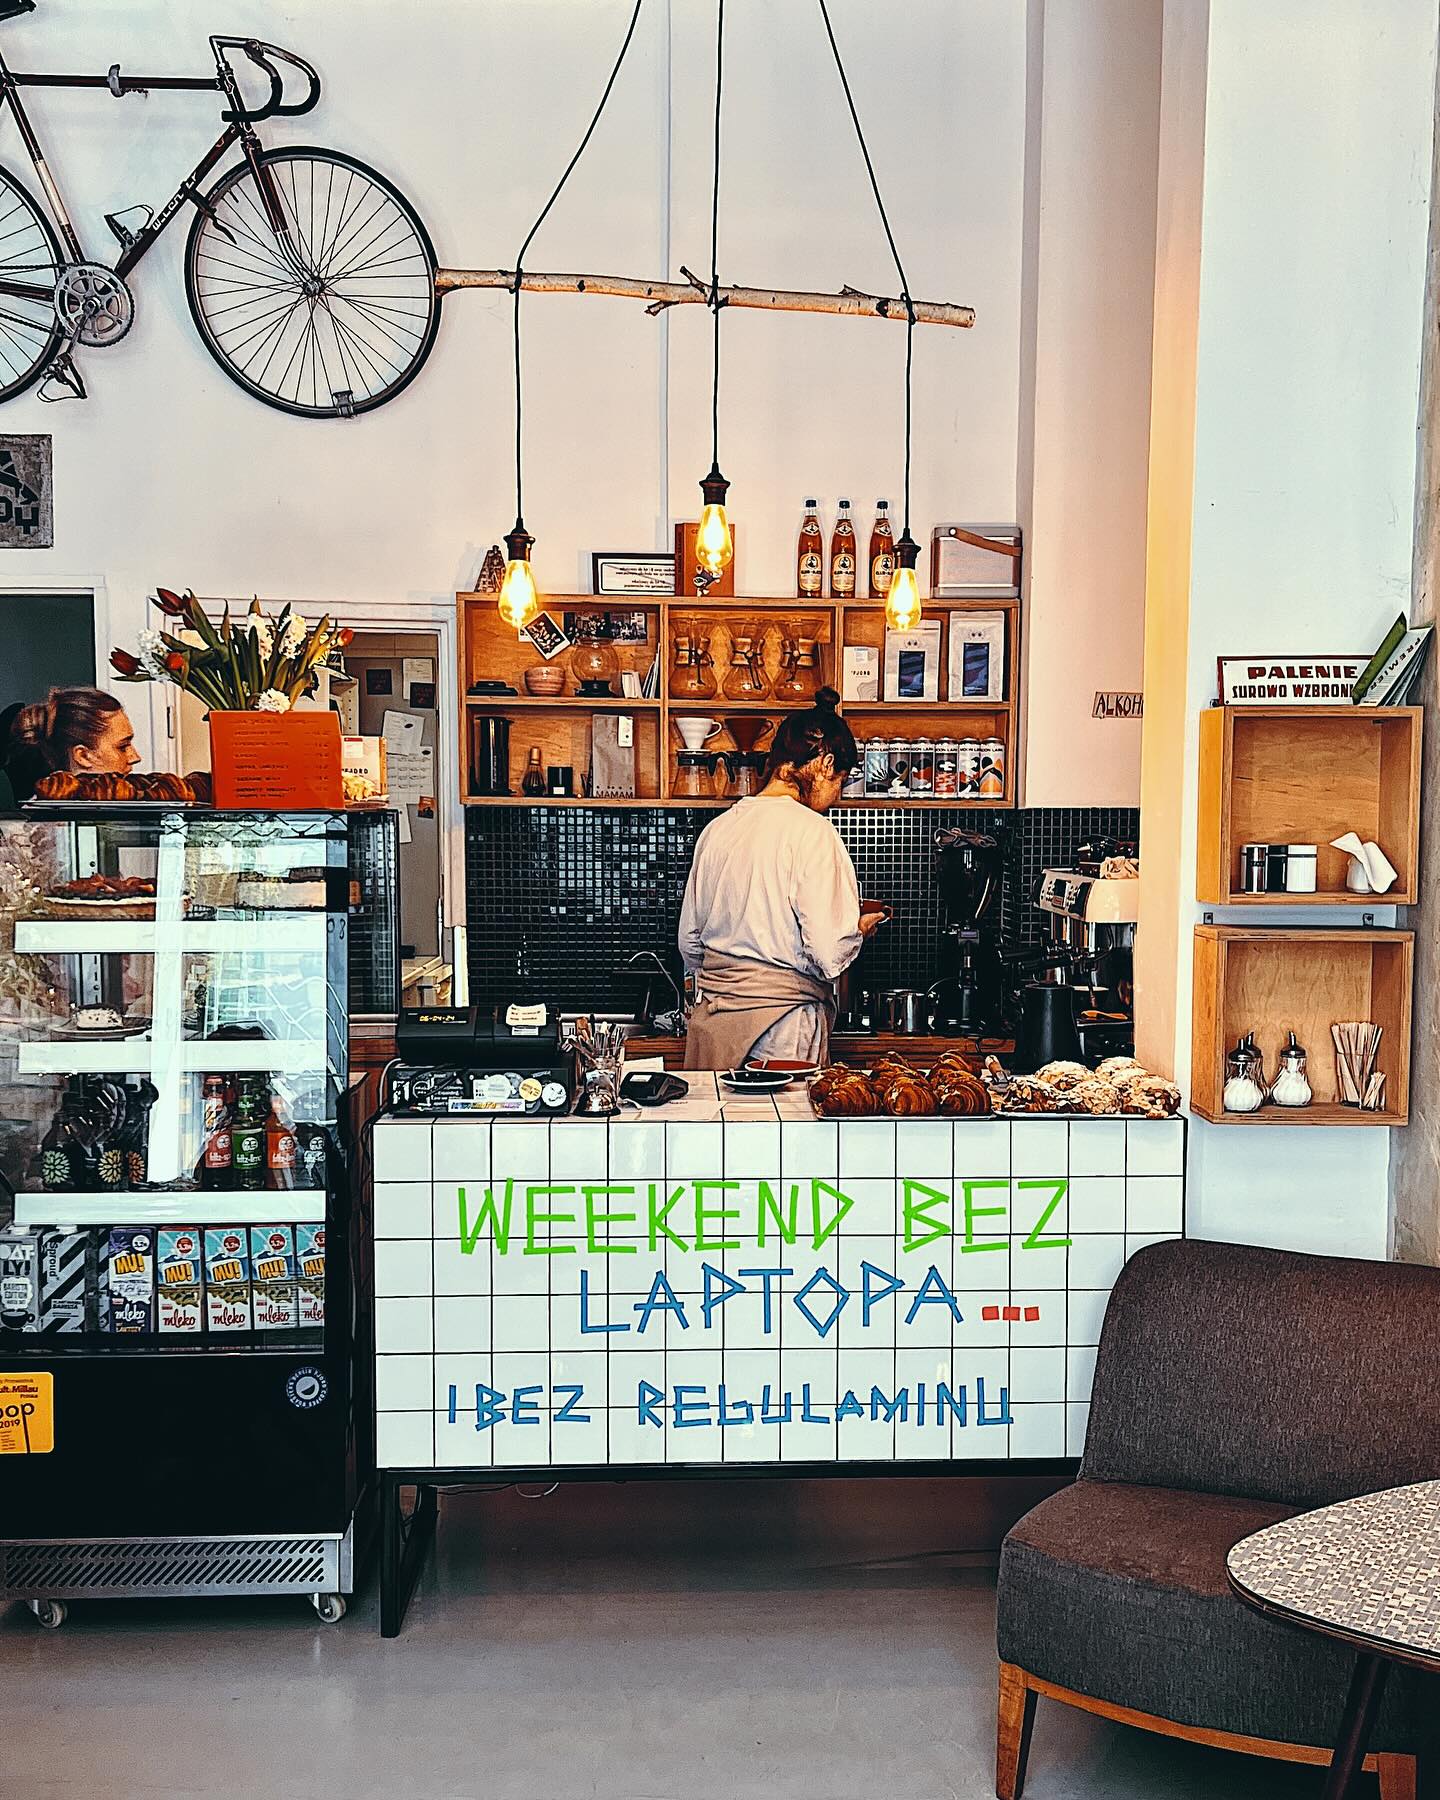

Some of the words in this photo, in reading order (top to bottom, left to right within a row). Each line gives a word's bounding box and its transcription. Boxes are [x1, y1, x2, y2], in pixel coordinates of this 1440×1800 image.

[1247, 665, 1358, 679] PALENIE
[1232, 684, 1287, 699] SUROWO
[1095, 693, 1143, 717] ALKOH
[457, 1177, 855, 1254] WEEKEND
[903, 1178, 1073, 1253] BEZ
[115, 1253, 145, 1275] MU!
[164, 1262, 193, 1284] MU!
[213, 1260, 241, 1282] MU!
[258, 1258, 286, 1281] MU!
[114, 1303, 146, 1322] mleko
[162, 1308, 196, 1328] mleko
[212, 1306, 246, 1327] mleko
[257, 1304, 290, 1324] mleko
[638, 1376, 1015, 1429] REGULAMINU
